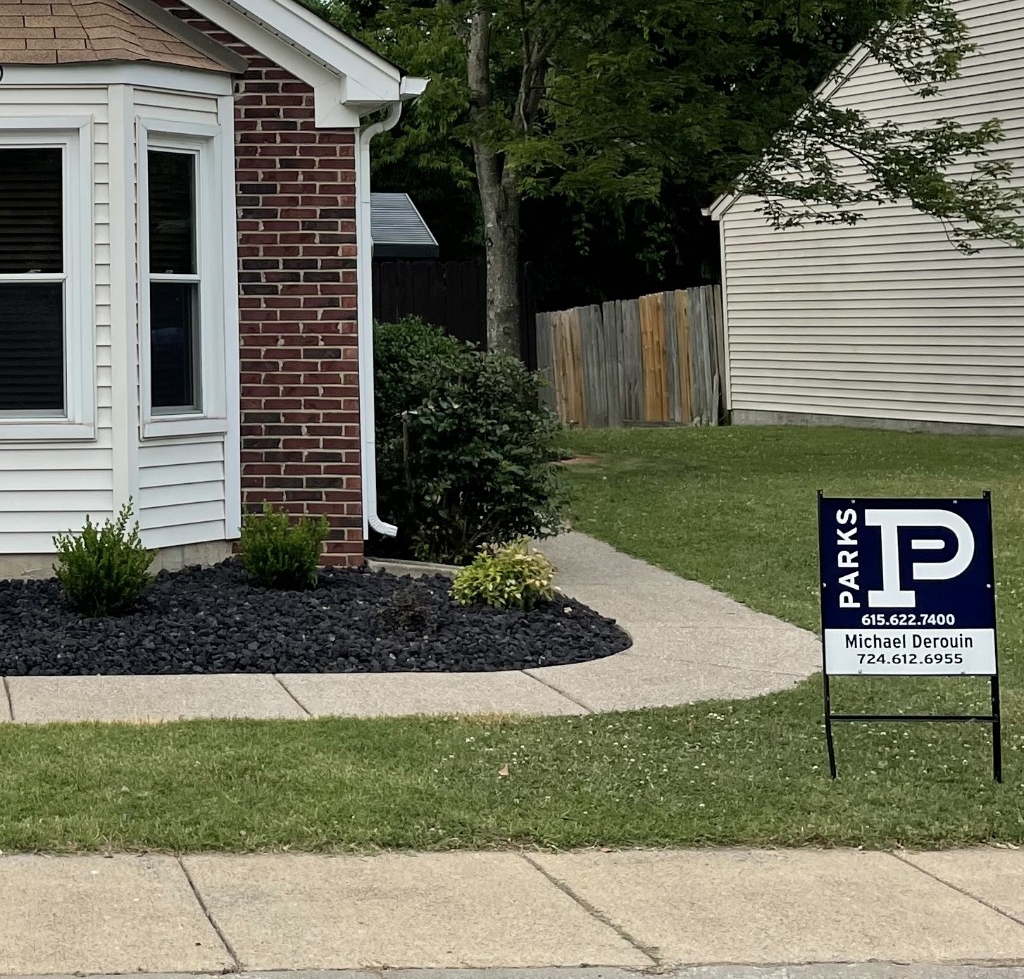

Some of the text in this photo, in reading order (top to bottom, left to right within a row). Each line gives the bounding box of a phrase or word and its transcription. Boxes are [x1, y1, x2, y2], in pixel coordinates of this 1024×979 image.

[836, 508, 861, 608] PARKS
[861, 613, 956, 626] 615.622.7400
[845, 633, 973, 649] Michael Derouin
[857, 653, 963, 665] 724.612.6955
